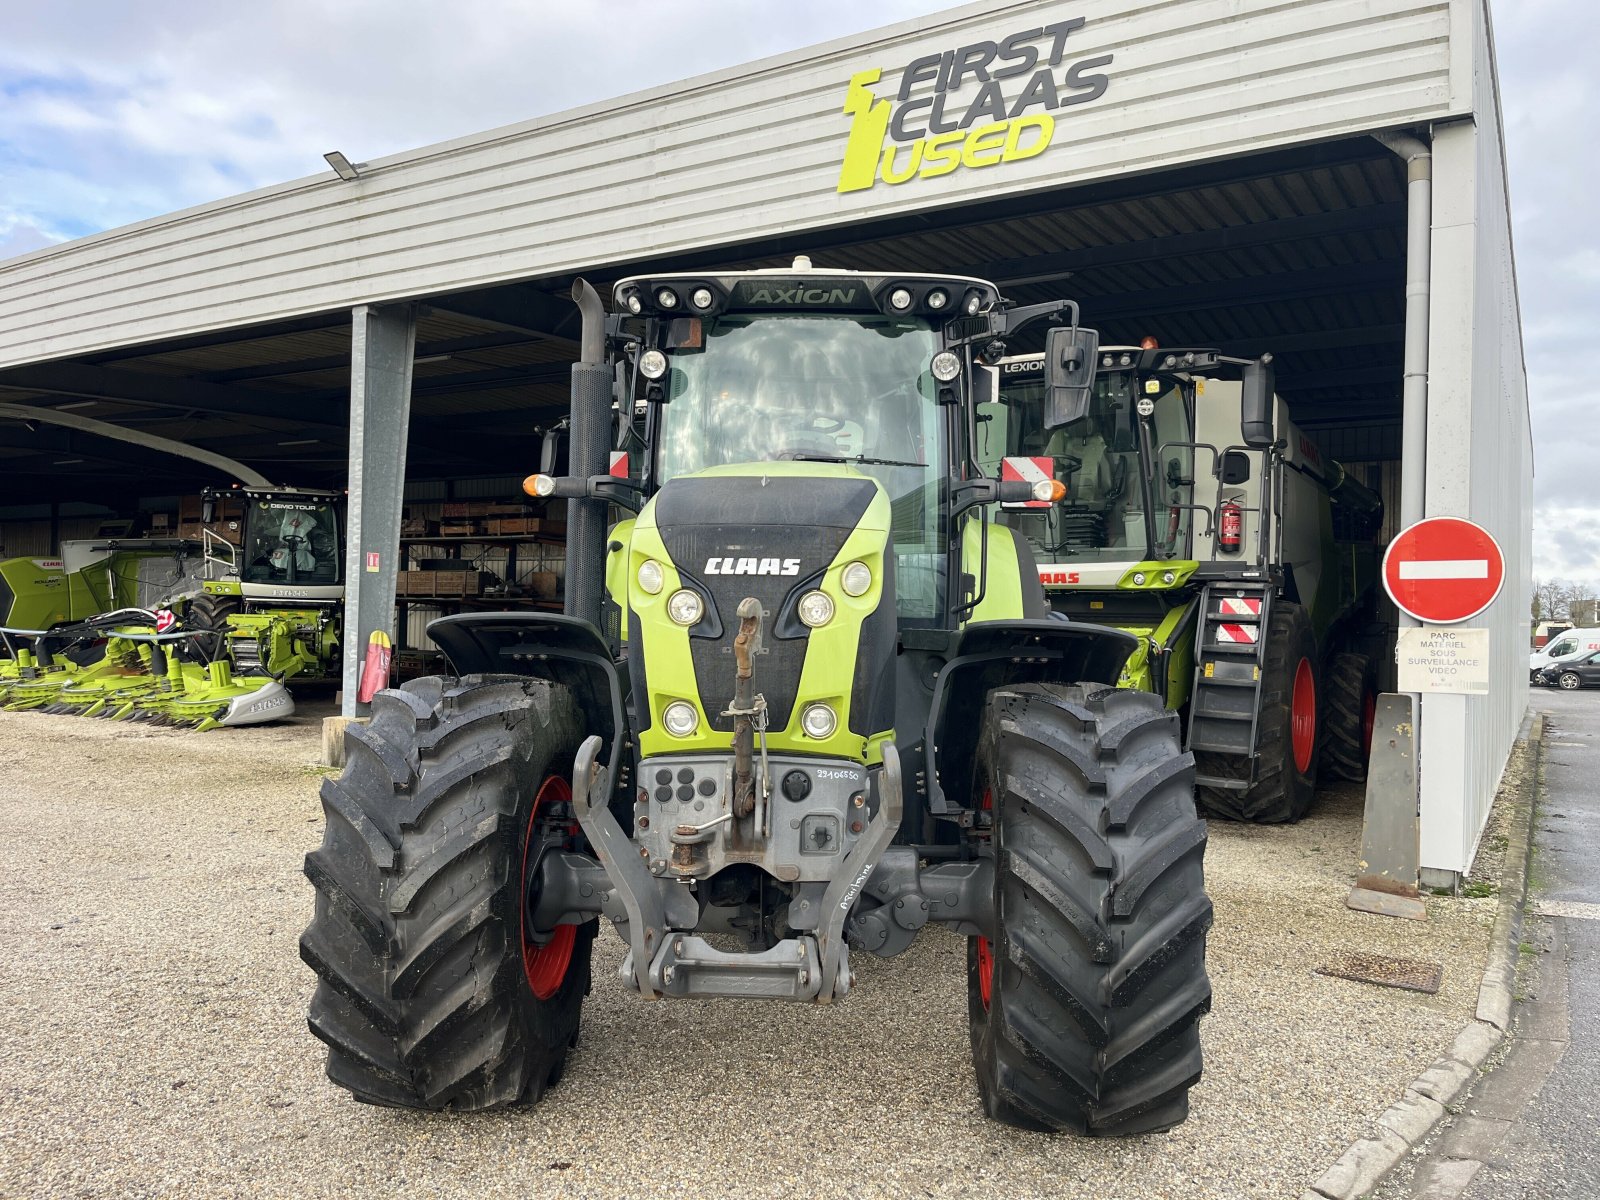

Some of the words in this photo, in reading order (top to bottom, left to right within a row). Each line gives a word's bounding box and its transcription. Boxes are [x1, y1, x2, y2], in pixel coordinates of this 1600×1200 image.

[897, 16, 1085, 101] FIRST
[890, 54, 1114, 141] CLAAS
[880, 114, 1056, 184] USED
[748, 289, 856, 304] AXION
[703, 557, 801, 576] CLAAS
[1039, 573, 1080, 584] AAS
[1430, 632, 1456, 640] PARC
[1430, 649, 1456, 657] SOUS
[1408, 658, 1479, 667] SURVEILLANCE
